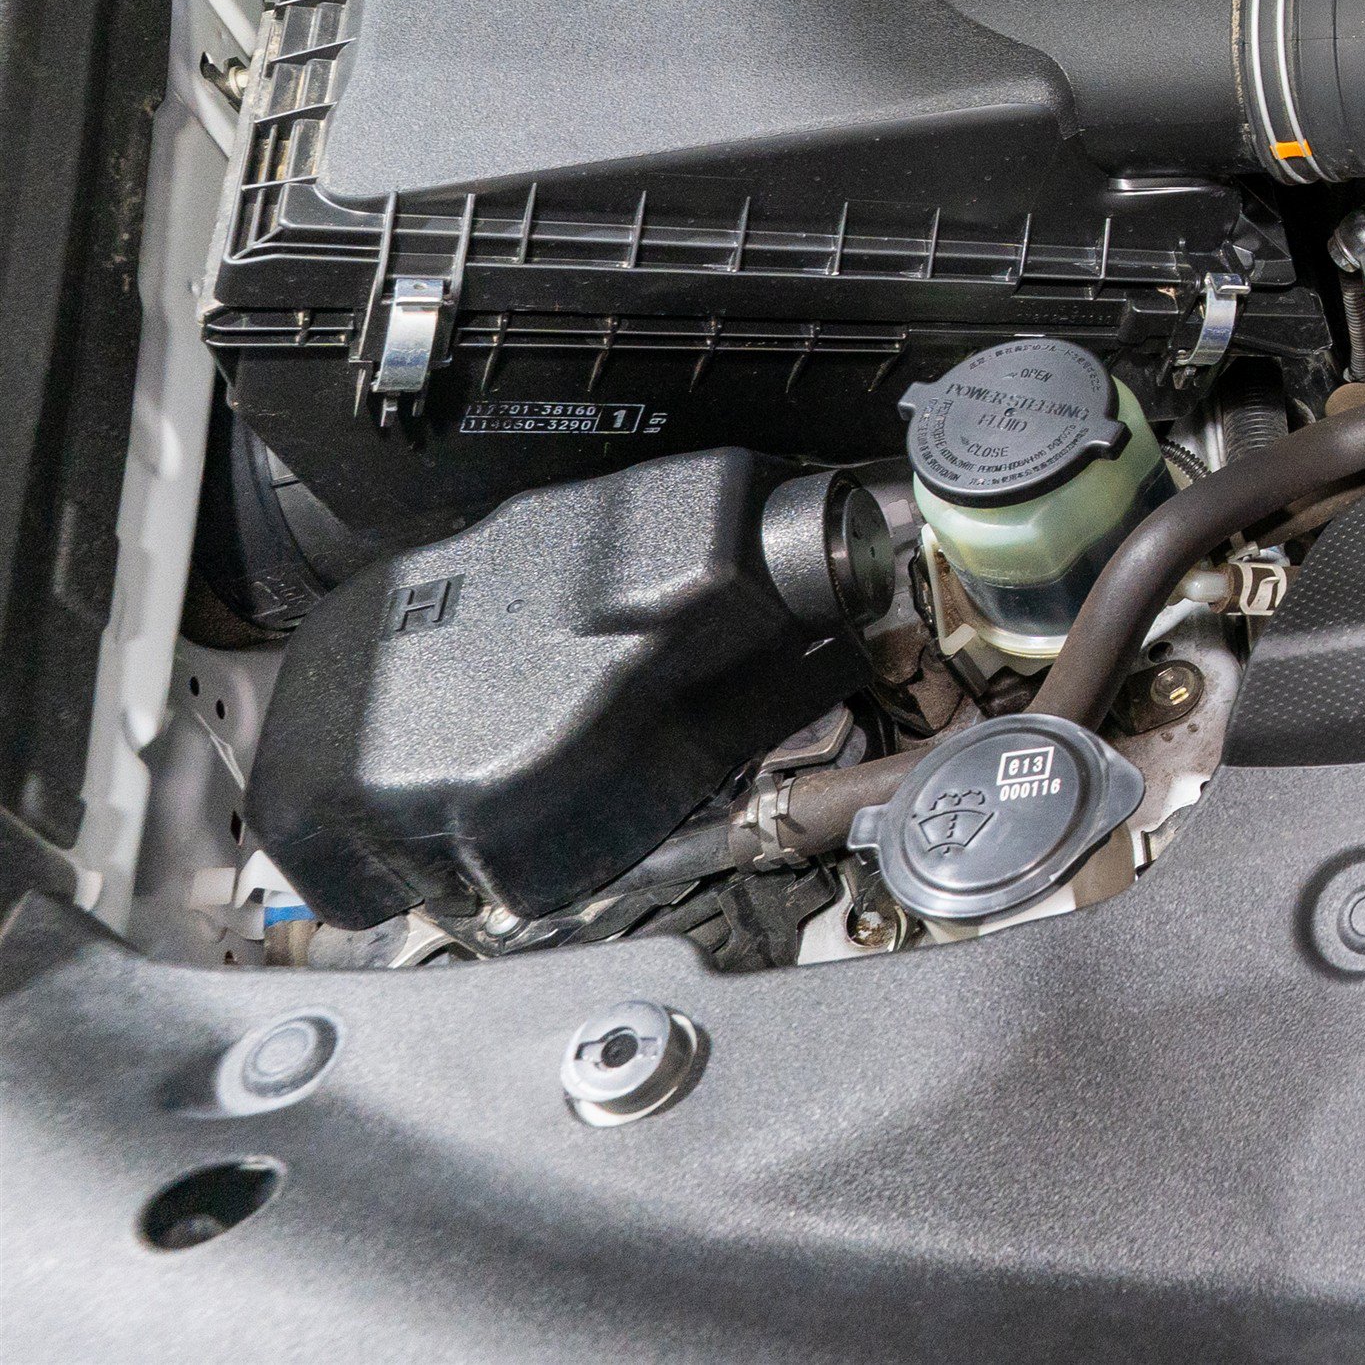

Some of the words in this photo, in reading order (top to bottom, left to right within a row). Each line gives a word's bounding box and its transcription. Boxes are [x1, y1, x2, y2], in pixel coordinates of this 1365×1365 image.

[1019, 367, 1054, 384] OPEN
[946, 383, 1006, 408] POWER
[1006, 394, 1090, 421] STEERING
[611, 409, 628, 429] 1
[977, 411, 1029, 434] FLUID
[966, 442, 1011, 459] CLOSE
[1007, 755, 1043, 777] e13
[999, 777, 1062, 802] 000116
